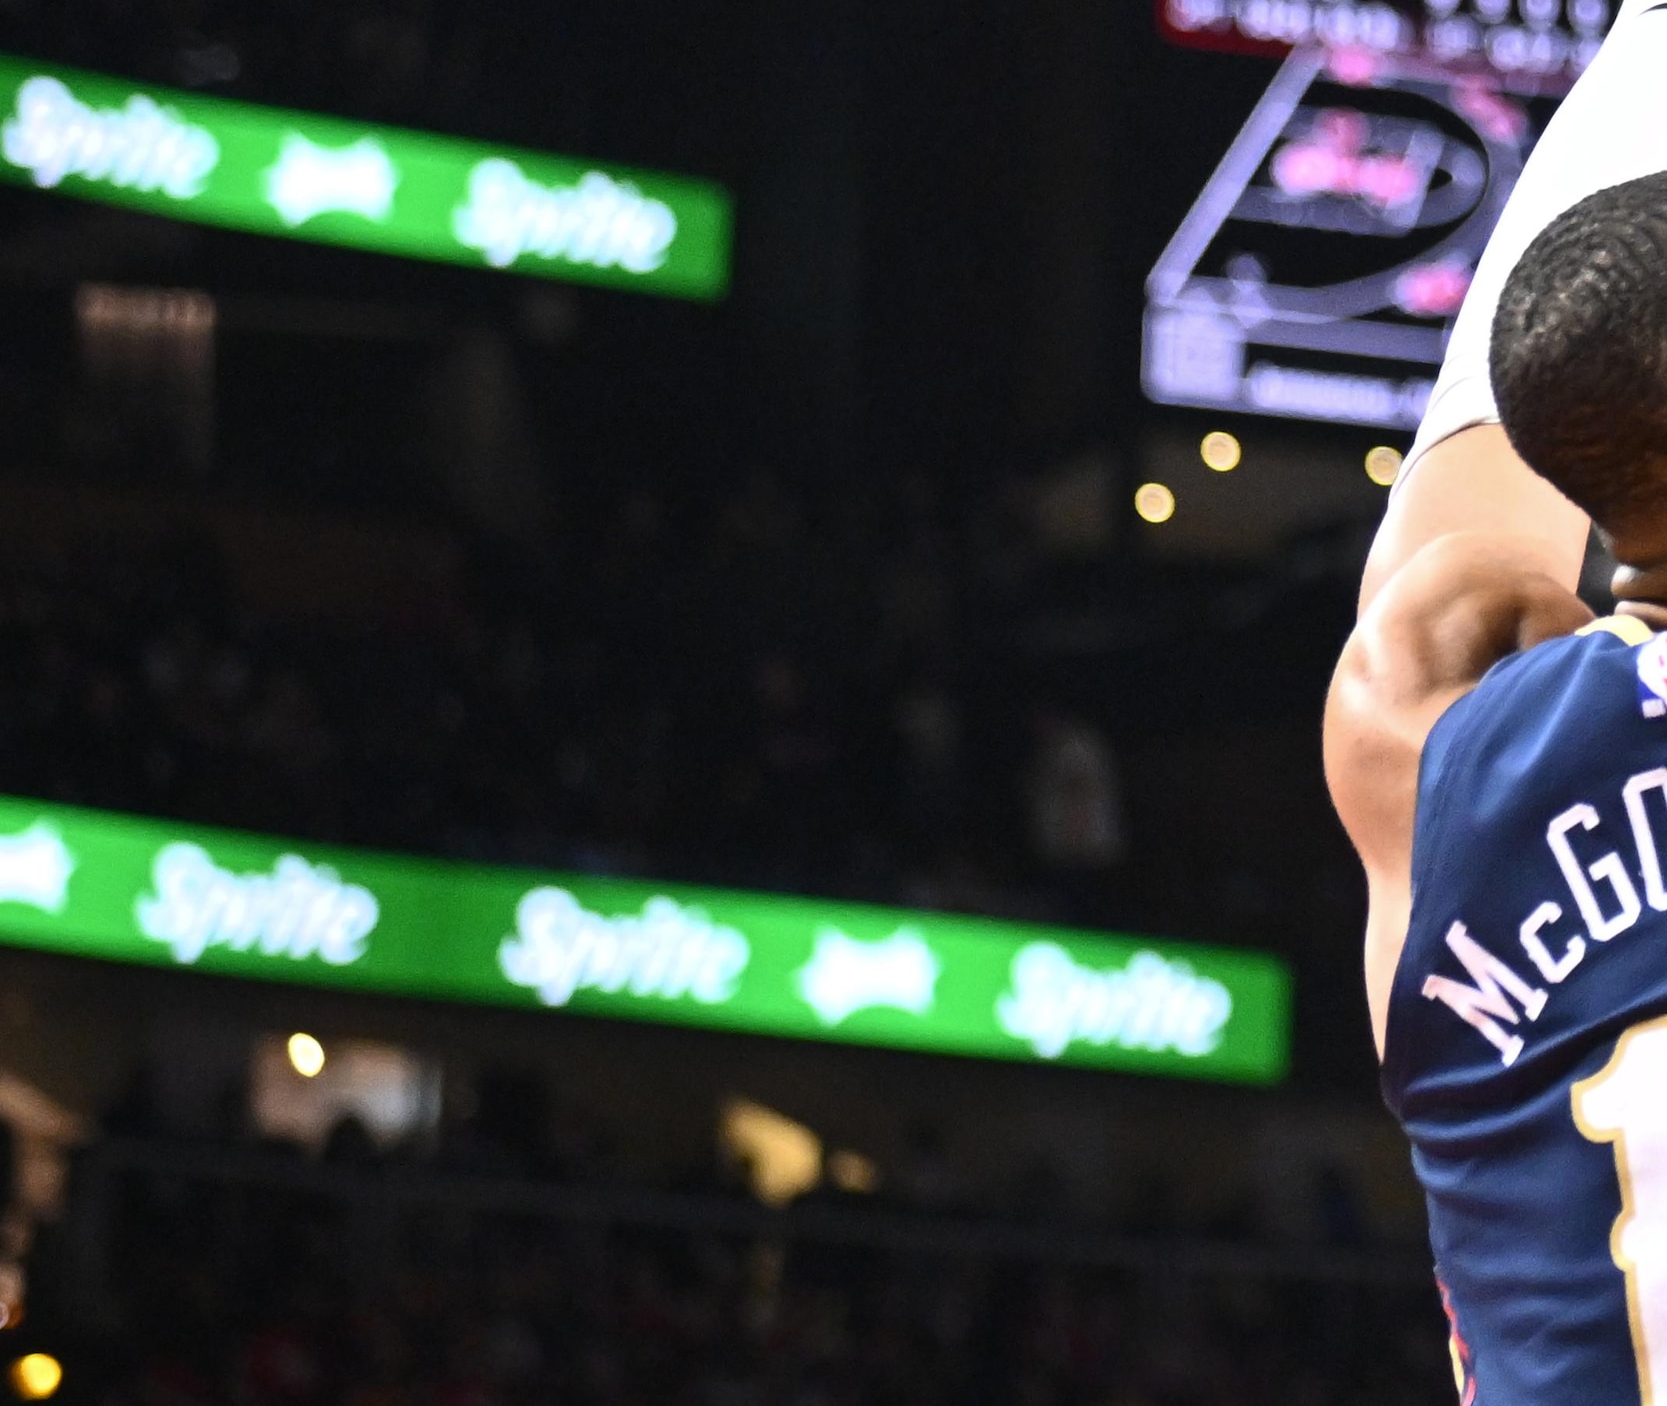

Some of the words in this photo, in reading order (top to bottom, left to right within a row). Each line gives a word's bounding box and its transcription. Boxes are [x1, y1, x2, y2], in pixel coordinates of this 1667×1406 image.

[2, 76, 220, 199] Sprite
[452, 157, 677, 273] Sprite
[135, 841, 379, 965] Sprite
[499, 886, 750, 1006] Sprite
[995, 942, 1232, 1058] Sprite
